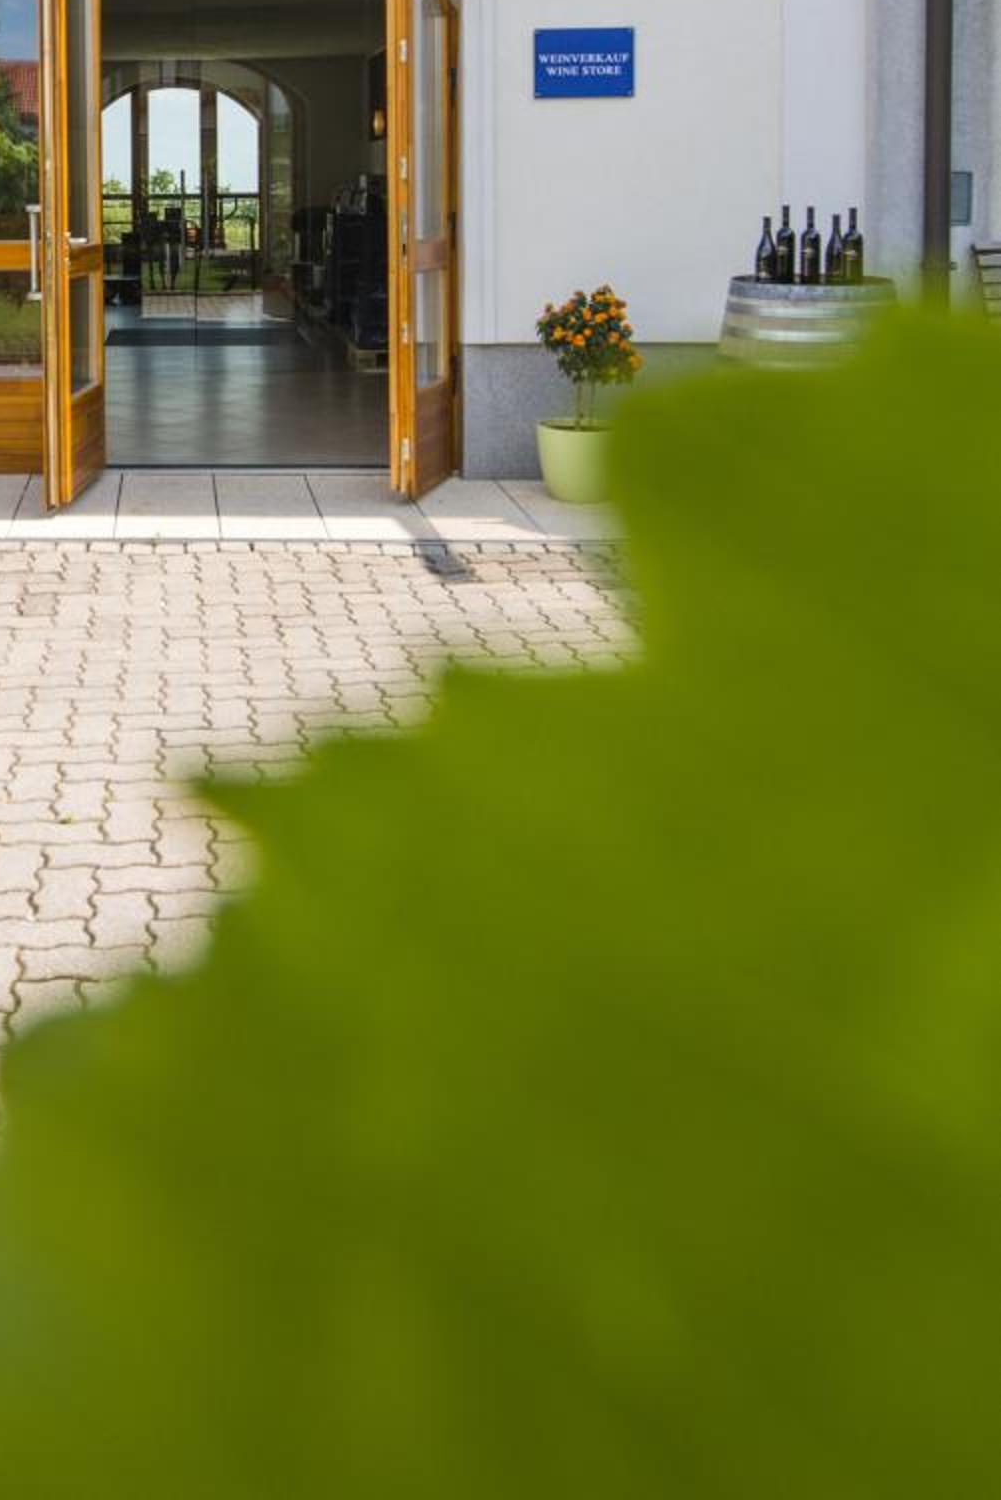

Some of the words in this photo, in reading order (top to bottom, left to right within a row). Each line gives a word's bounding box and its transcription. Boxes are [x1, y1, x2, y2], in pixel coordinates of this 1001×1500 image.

[538, 53, 629, 64] WEINVERKAUF
[545, 65, 579, 76] WINE
[581, 65, 622, 76] STORE
